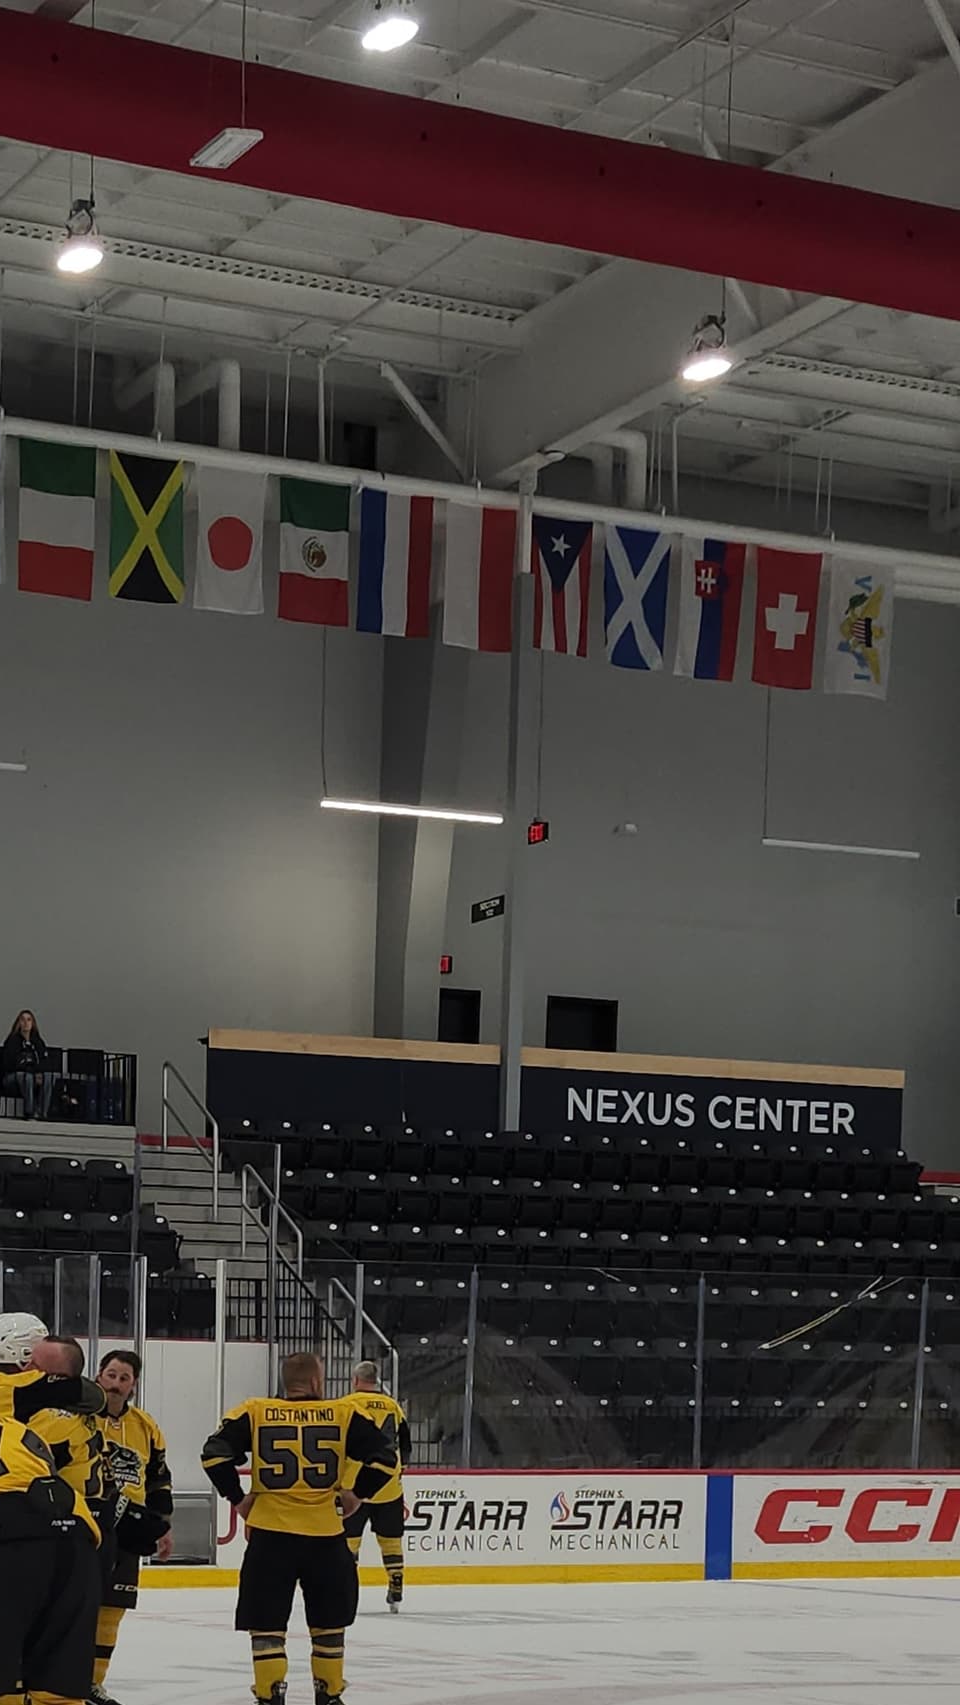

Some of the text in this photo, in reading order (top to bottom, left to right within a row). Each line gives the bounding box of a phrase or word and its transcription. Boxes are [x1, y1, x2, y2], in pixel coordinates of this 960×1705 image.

[567, 1087, 855, 1135] NEXUS CENTER
[265, 1408, 334, 1422] COSTANTINO
[258, 1426, 340, 1490] 55
[415, 1490, 468, 1499] STEPHEN S.
[574, 1489, 626, 1499] STEPHEN S.
[404, 1501, 528, 1531] STARR
[551, 1500, 684, 1531] STARR
[407, 1534, 525, 1551] ECHANICAL
[549, 1533, 680, 1551] MECHANICAL
[113, 1583, 137, 1592] CC
